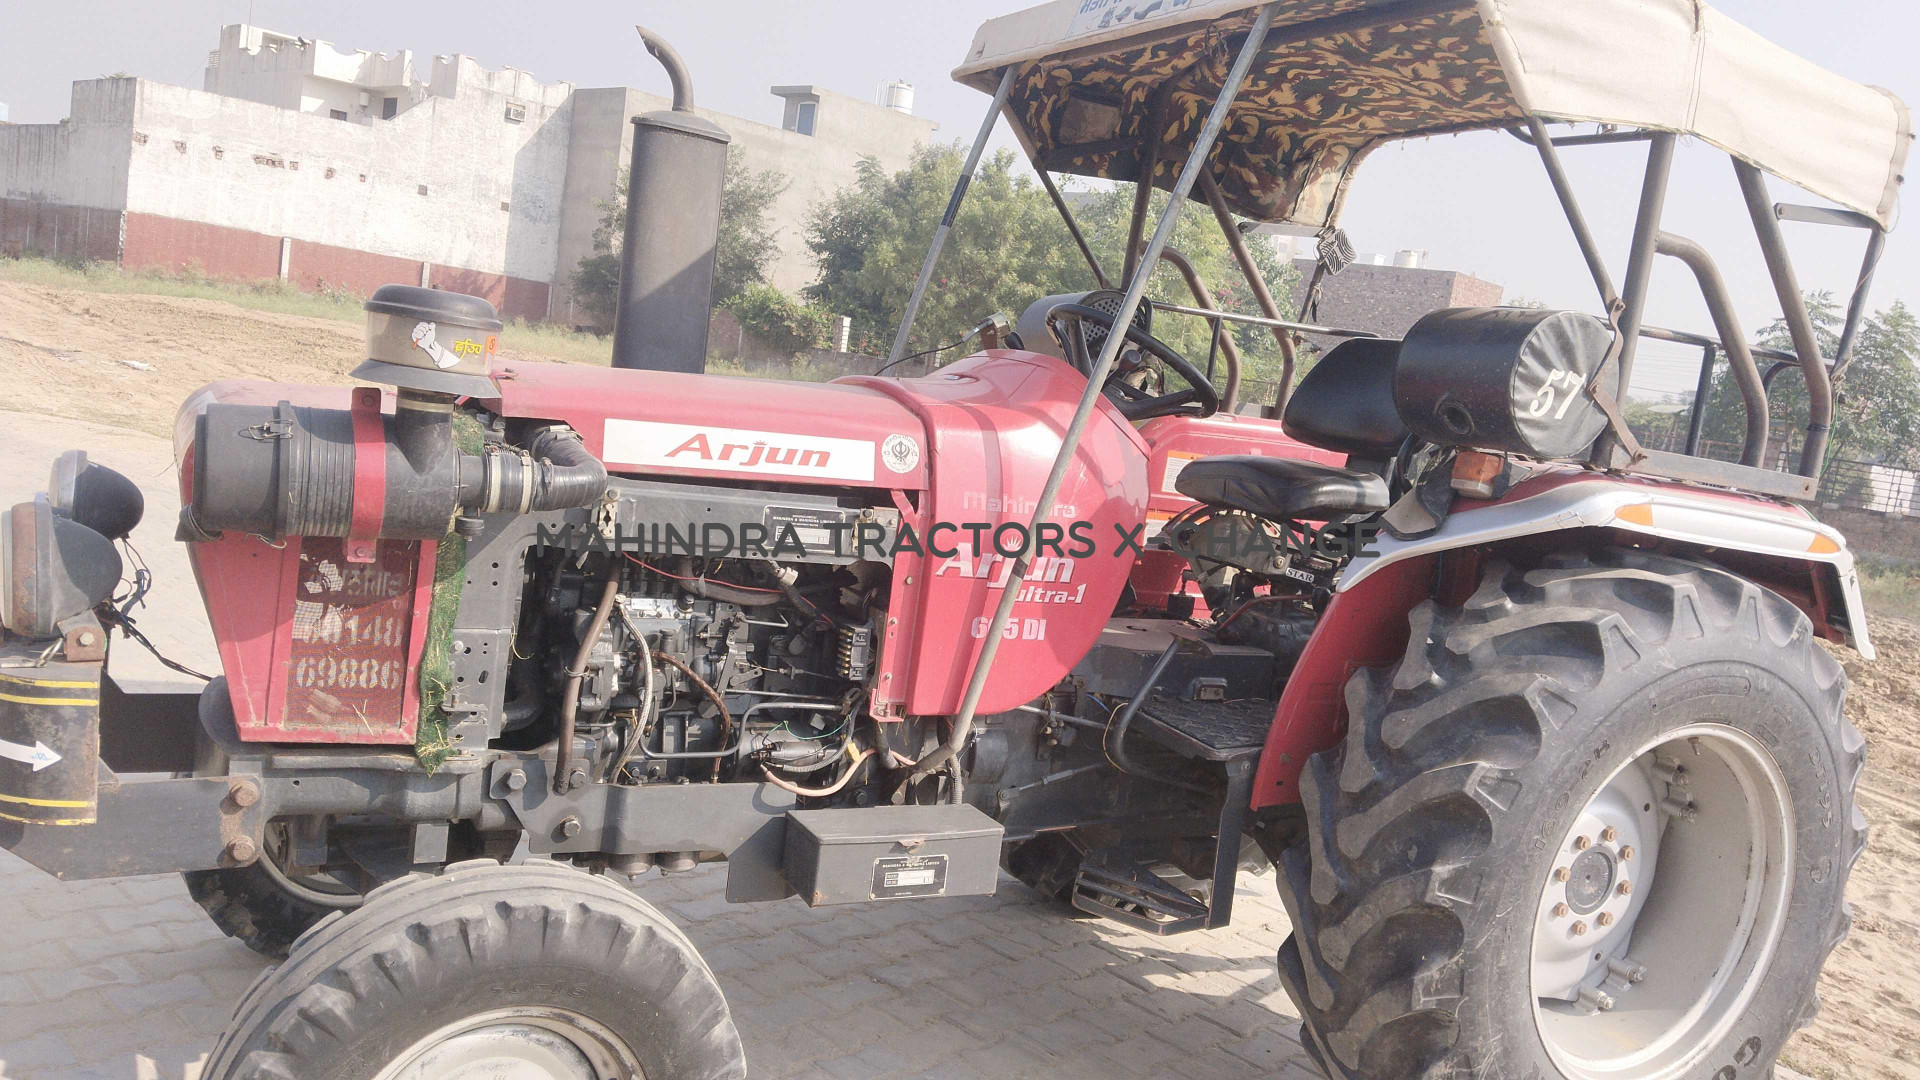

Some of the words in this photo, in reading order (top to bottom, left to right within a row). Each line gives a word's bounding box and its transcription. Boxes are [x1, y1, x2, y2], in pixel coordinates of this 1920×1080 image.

[1529, 367, 1587, 420] 57
[663, 432, 832, 468] Arjun
[963, 491, 1077, 519] Mahinra
[1287, 569, 1314, 582] STAR
[971, 616, 1020, 640] 65
[1022, 618, 1047, 641] DI
